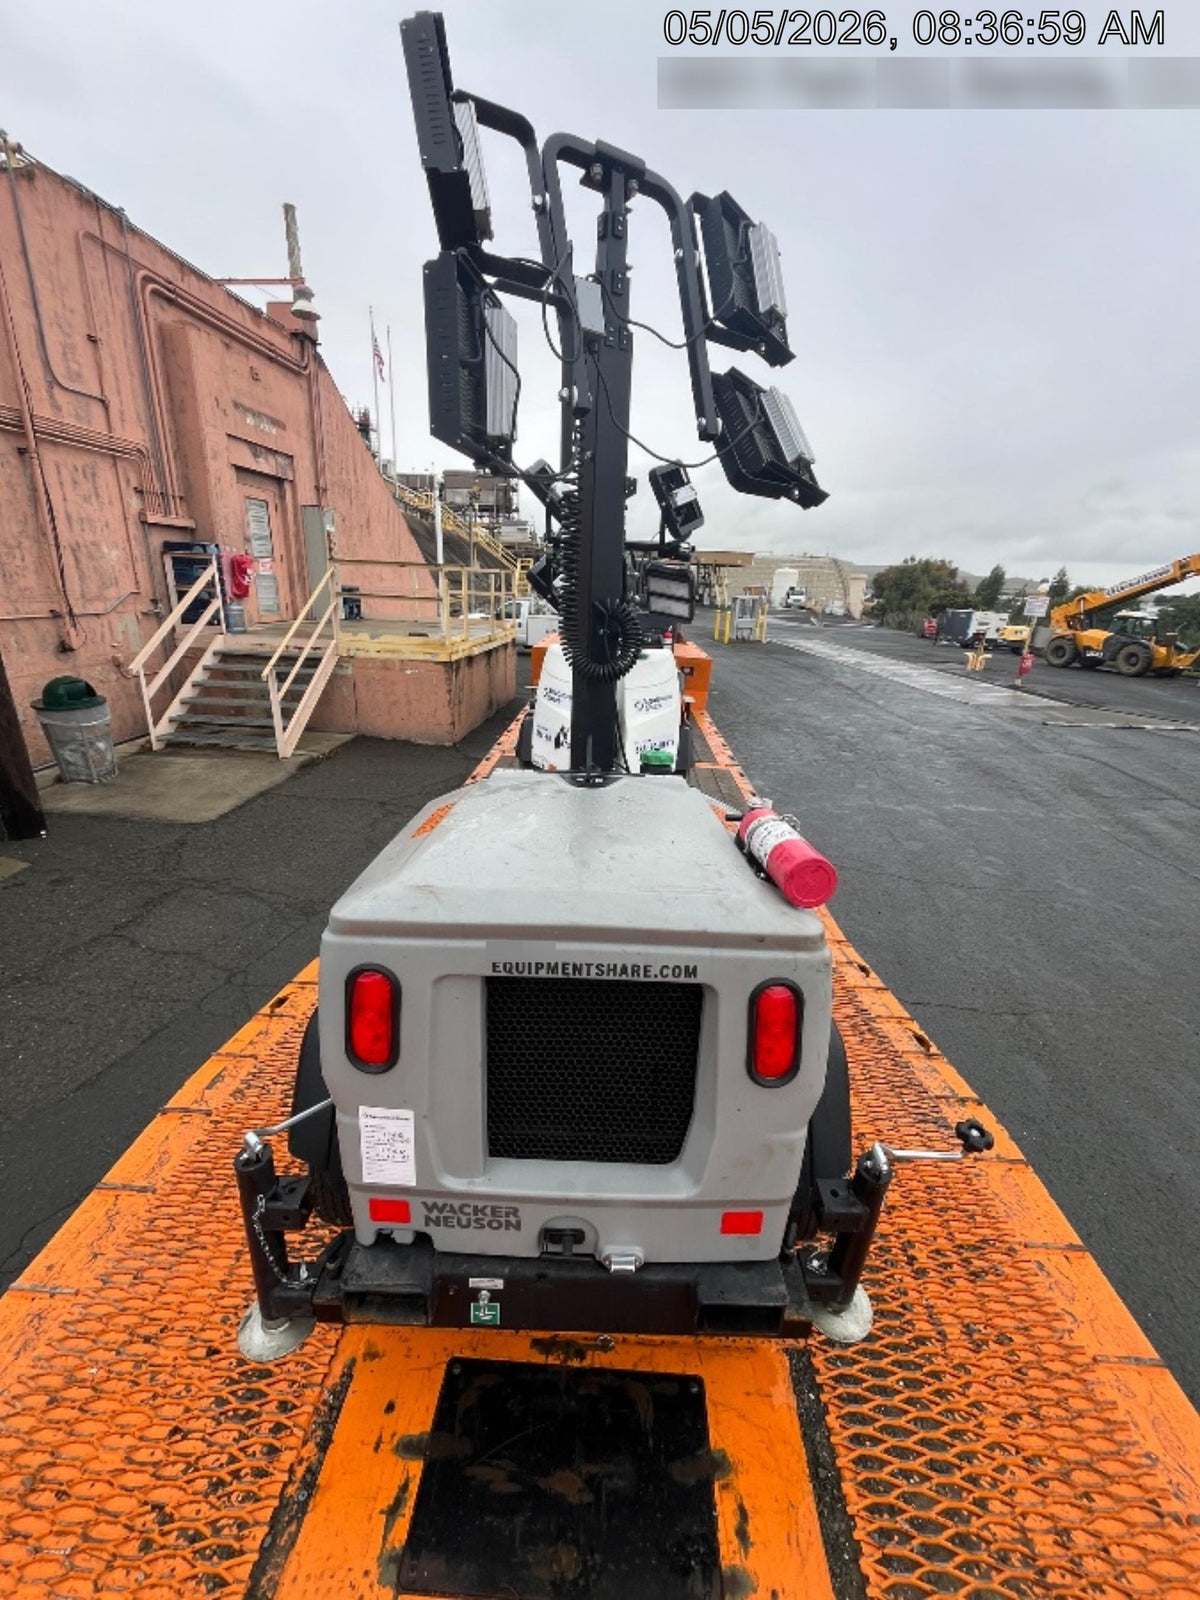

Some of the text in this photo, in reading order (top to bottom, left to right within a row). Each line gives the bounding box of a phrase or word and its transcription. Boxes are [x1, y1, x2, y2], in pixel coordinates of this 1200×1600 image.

[491, 961, 698, 979] EQUIPMENTSHARE.COM
[421, 1201, 520, 1218] WACKER
[424, 1215, 522, 1232] NEUSON
